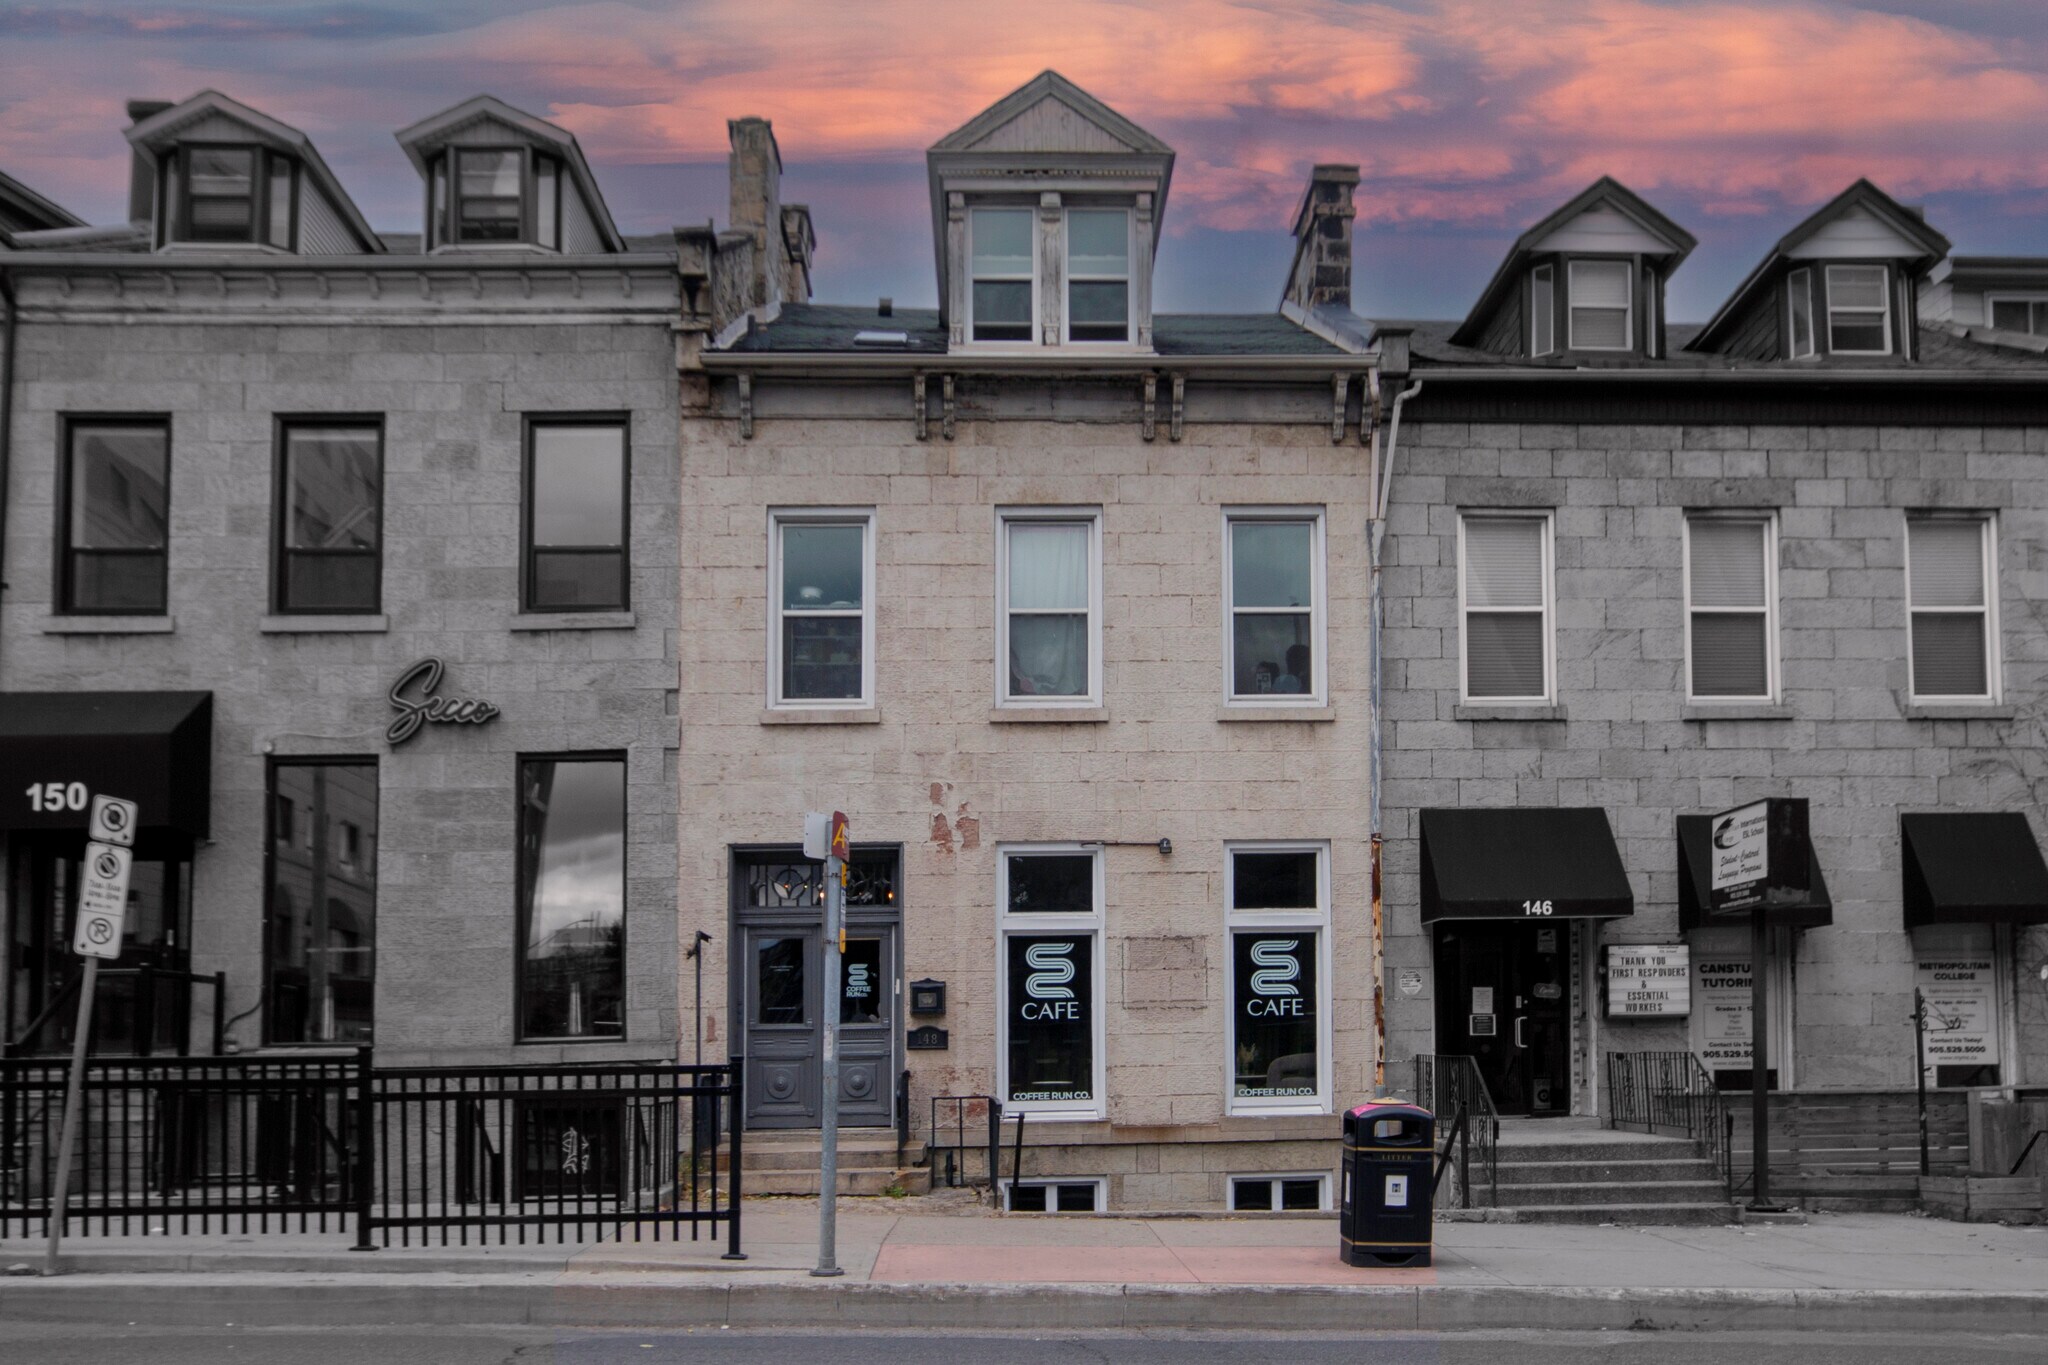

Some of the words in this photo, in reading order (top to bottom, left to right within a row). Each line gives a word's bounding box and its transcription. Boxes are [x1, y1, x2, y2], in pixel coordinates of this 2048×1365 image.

[385, 656, 499, 744] Secco
[26, 781, 88, 812] 150
[1522, 900, 1553, 916] 146
[1620, 956, 1646, 966] THANK
[1651, 956, 1666, 965] YOU
[1918, 962, 1991, 970] METROPOLITAN
[1612, 968, 1634, 978] FIRST
[1699, 963, 1752, 974] CANSTU
[1934, 972, 1976, 980] COLLEGE
[1627, 991, 1669, 1001] ESSENTIAL
[1021, 1001, 1080, 1020] CAFE
[1247, 998, 1304, 1016] CAFE
[917, 1033, 938, 1045] 148
[1702, 1050, 1754, 1058] 905.529.50
[1013, 1091, 1051, 1101] COFFEE
[1051, 1091, 1073, 1100] RUN
[1074, 1090, 1091, 1100] CO.
[1238, 1087, 1275, 1096] COFFEE
[1276, 1087, 1297, 1096] RUN
[1297, 1087, 1315, 1096] CO.
